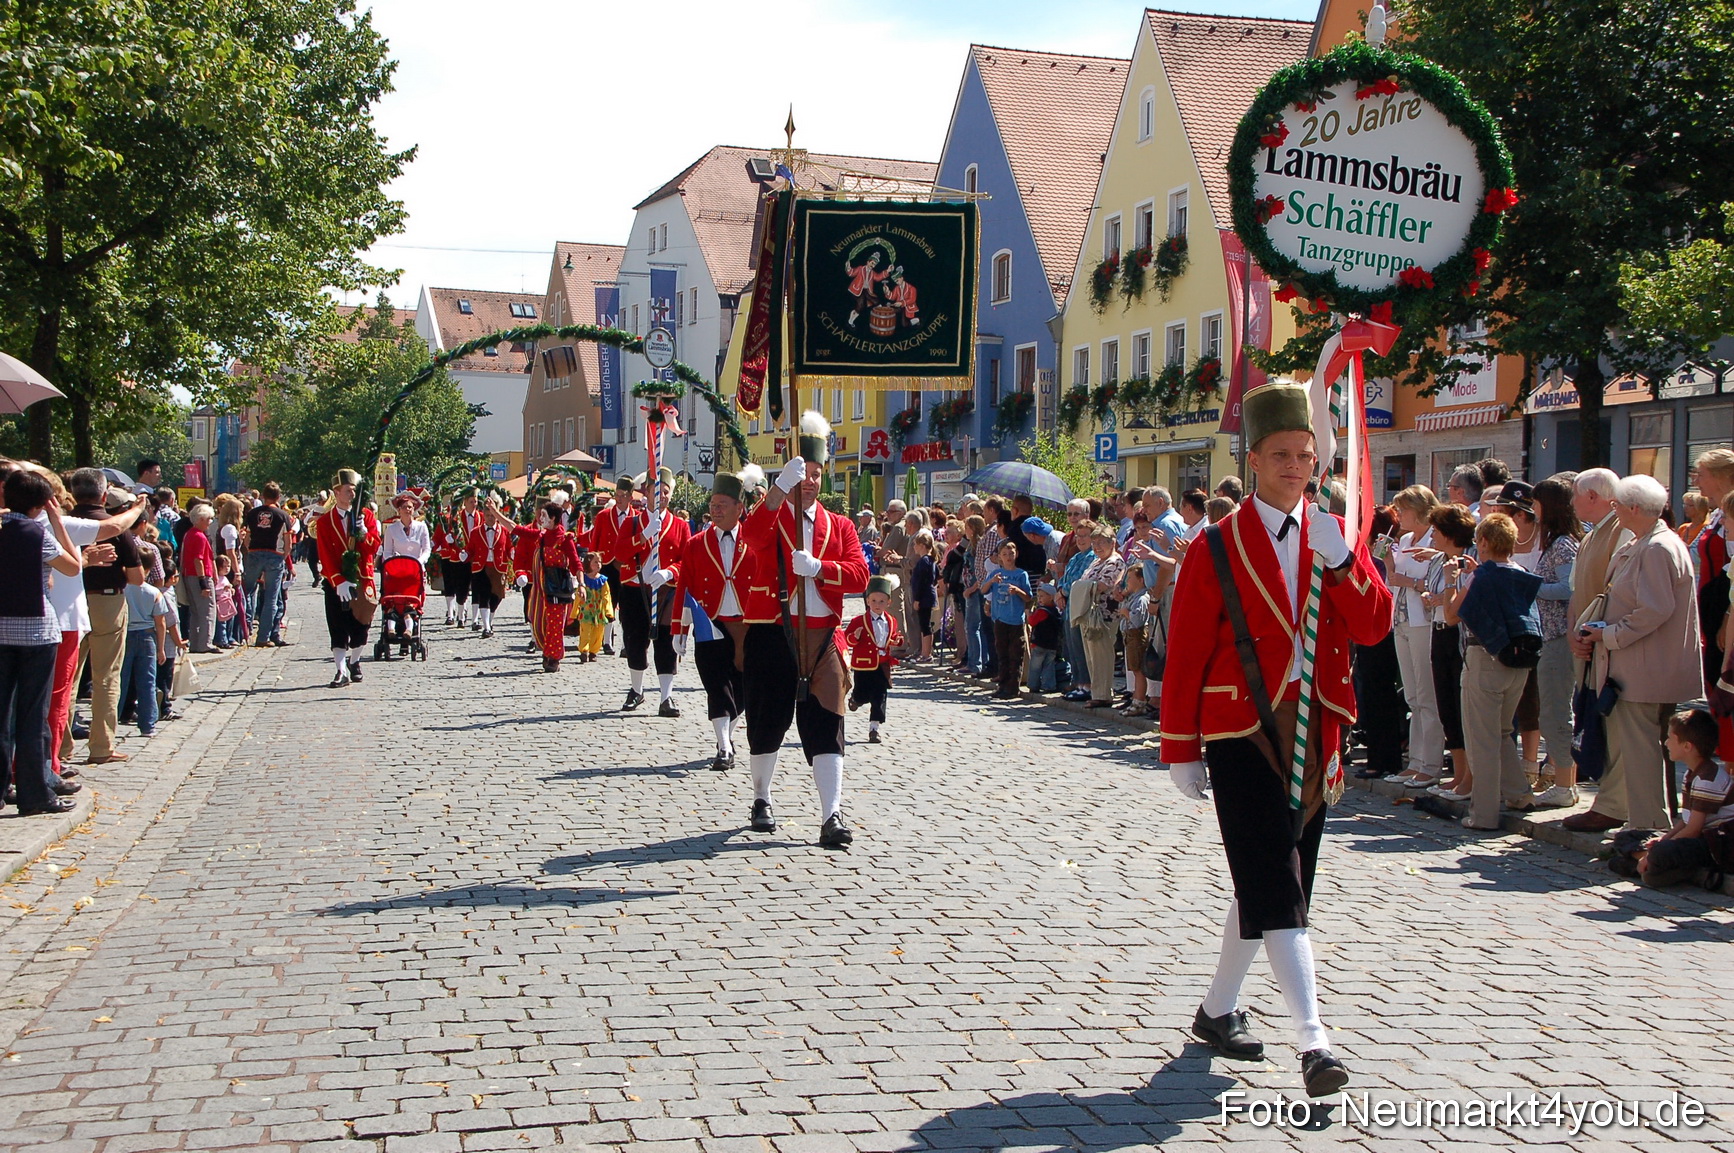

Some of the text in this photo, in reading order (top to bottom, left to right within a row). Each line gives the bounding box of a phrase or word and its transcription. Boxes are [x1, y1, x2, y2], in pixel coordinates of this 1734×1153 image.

[1300, 93, 1422, 147] 20 Jahre
[1264, 147, 1462, 203] Lammsbräu
[1286, 190, 1433, 244] Schäffler
[829, 222, 936, 260] Neumarkter Lammsbräu
[1297, 236, 1415, 278] Tanzgruppe
[817, 310, 949, 354] SCHÄFFLERTANZGRUPPE
[929, 348, 948, 356] 1990
[1452, 382, 1478, 398] Mode
[752, 453, 779, 465] Restaurant
[1101, 437, 1112, 459] P
